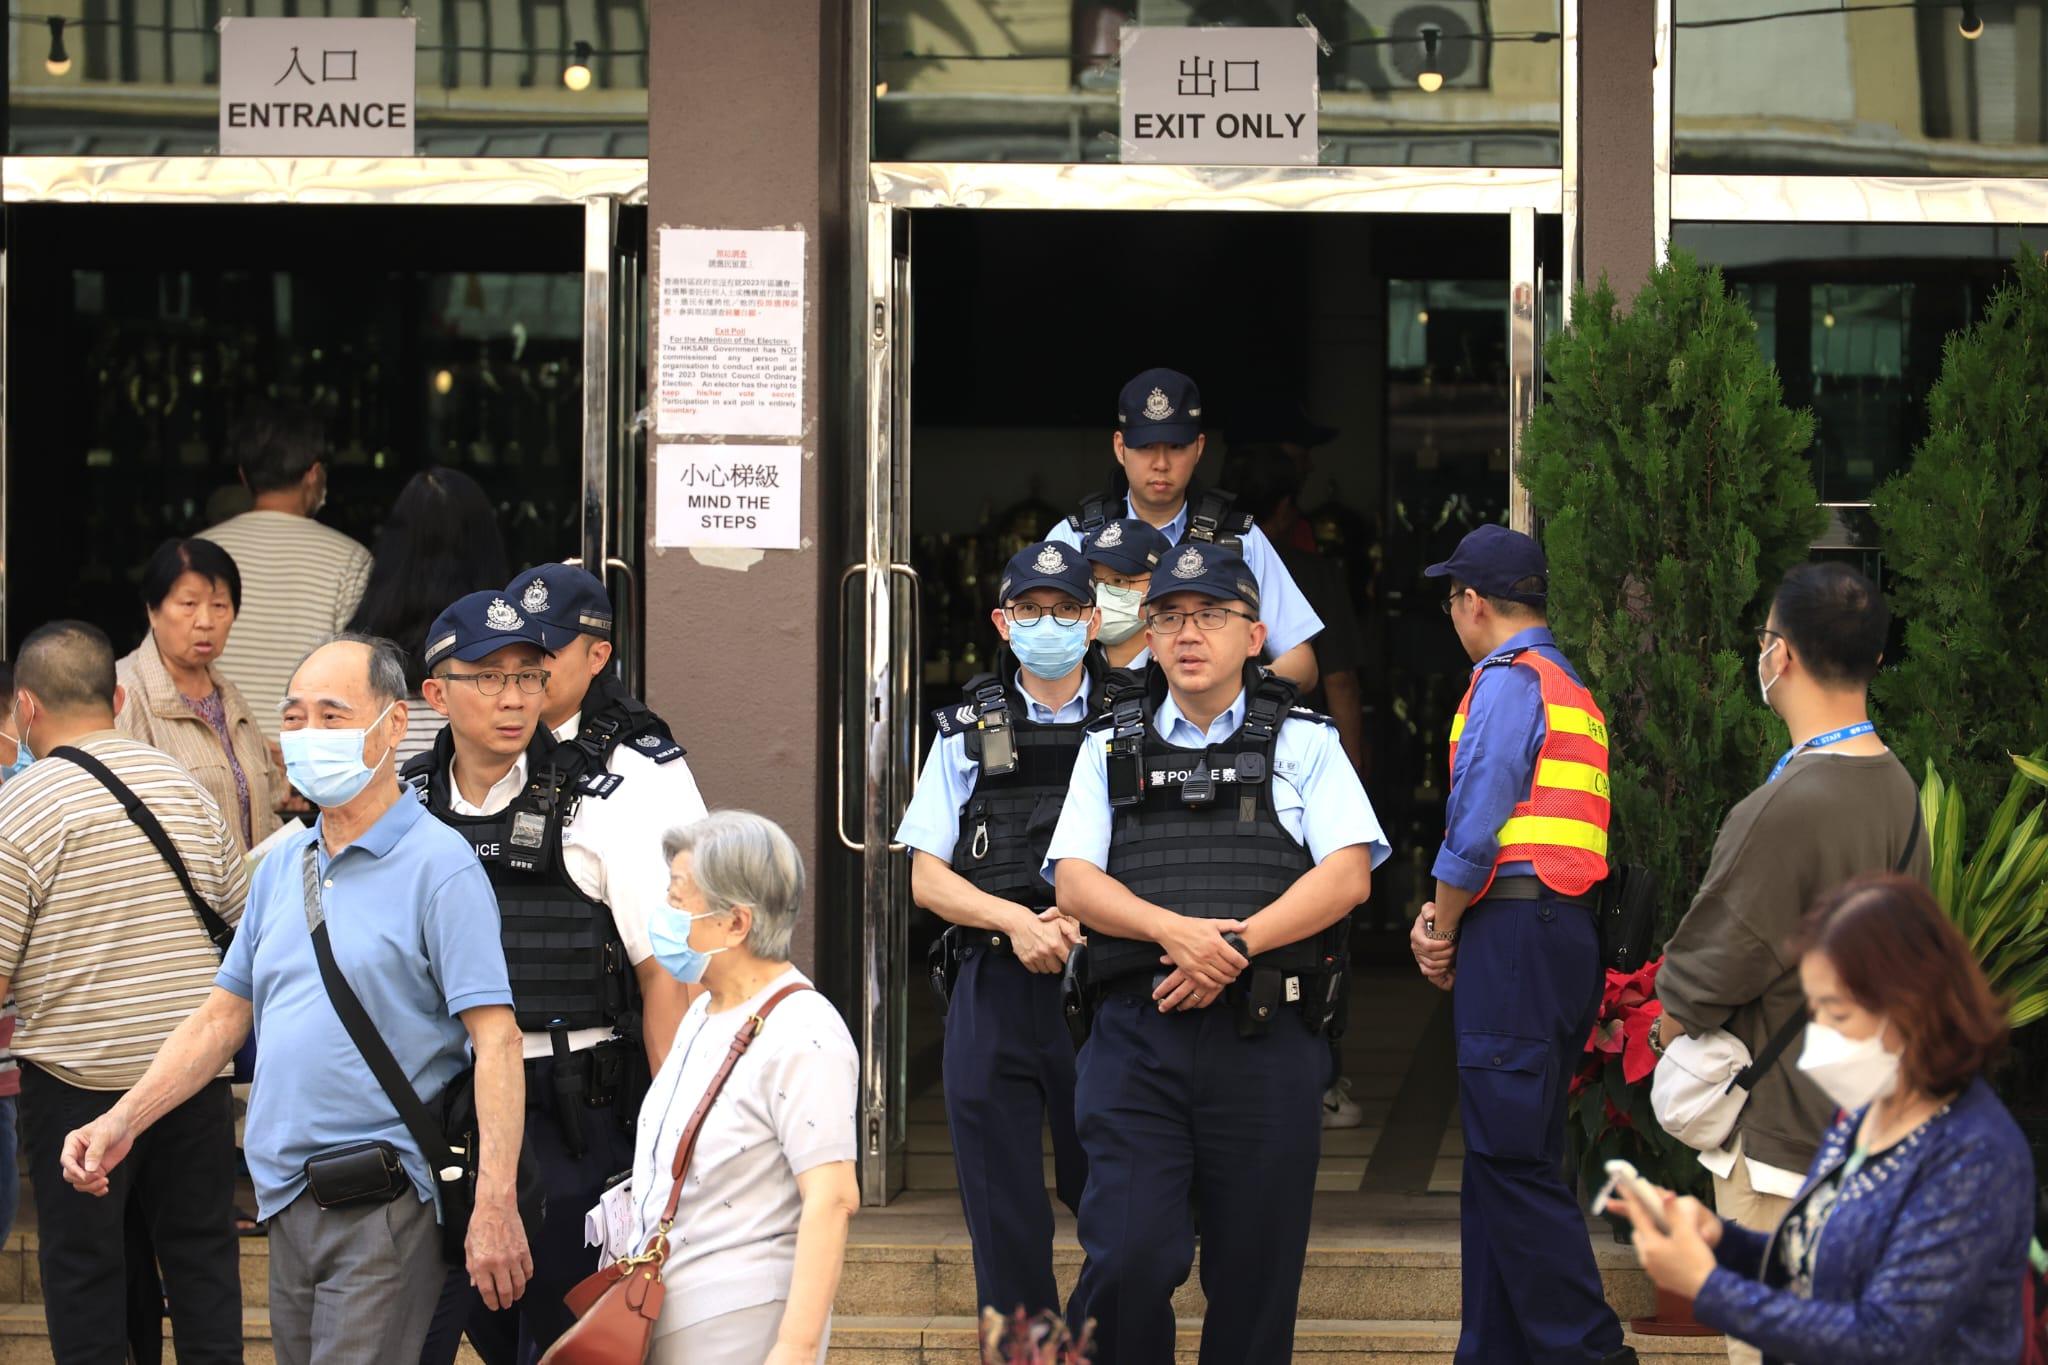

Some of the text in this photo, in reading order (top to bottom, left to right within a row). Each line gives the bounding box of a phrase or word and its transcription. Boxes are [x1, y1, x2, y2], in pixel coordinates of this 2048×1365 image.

[274, 46, 357, 86] 入口
[1178, 56, 1260, 97] 出口
[228, 103, 407, 128] ENTRANCE
[1134, 113, 1306, 139] EXIT ONLY
[715, 328, 746, 336] Exit Poll
[670, 336, 682, 344] For
[684, 336, 697, 344] the
[698, 336, 733, 344] Attention
[773, 364, 787, 372] poll
[764, 373, 796, 381] Ordinary
[770, 382, 788, 390] right
[662, 398, 709, 406] Participation
[769, 400, 796, 408] entirely
[680, 463, 780, 488] 小心梯級
[688, 495, 770, 509] MIND THE
[701, 515, 757, 529] STEPS
[1821, 732, 1842, 744] STAFF
[1168, 770, 1220, 782] POE
[475, 843, 500, 856] ICE
